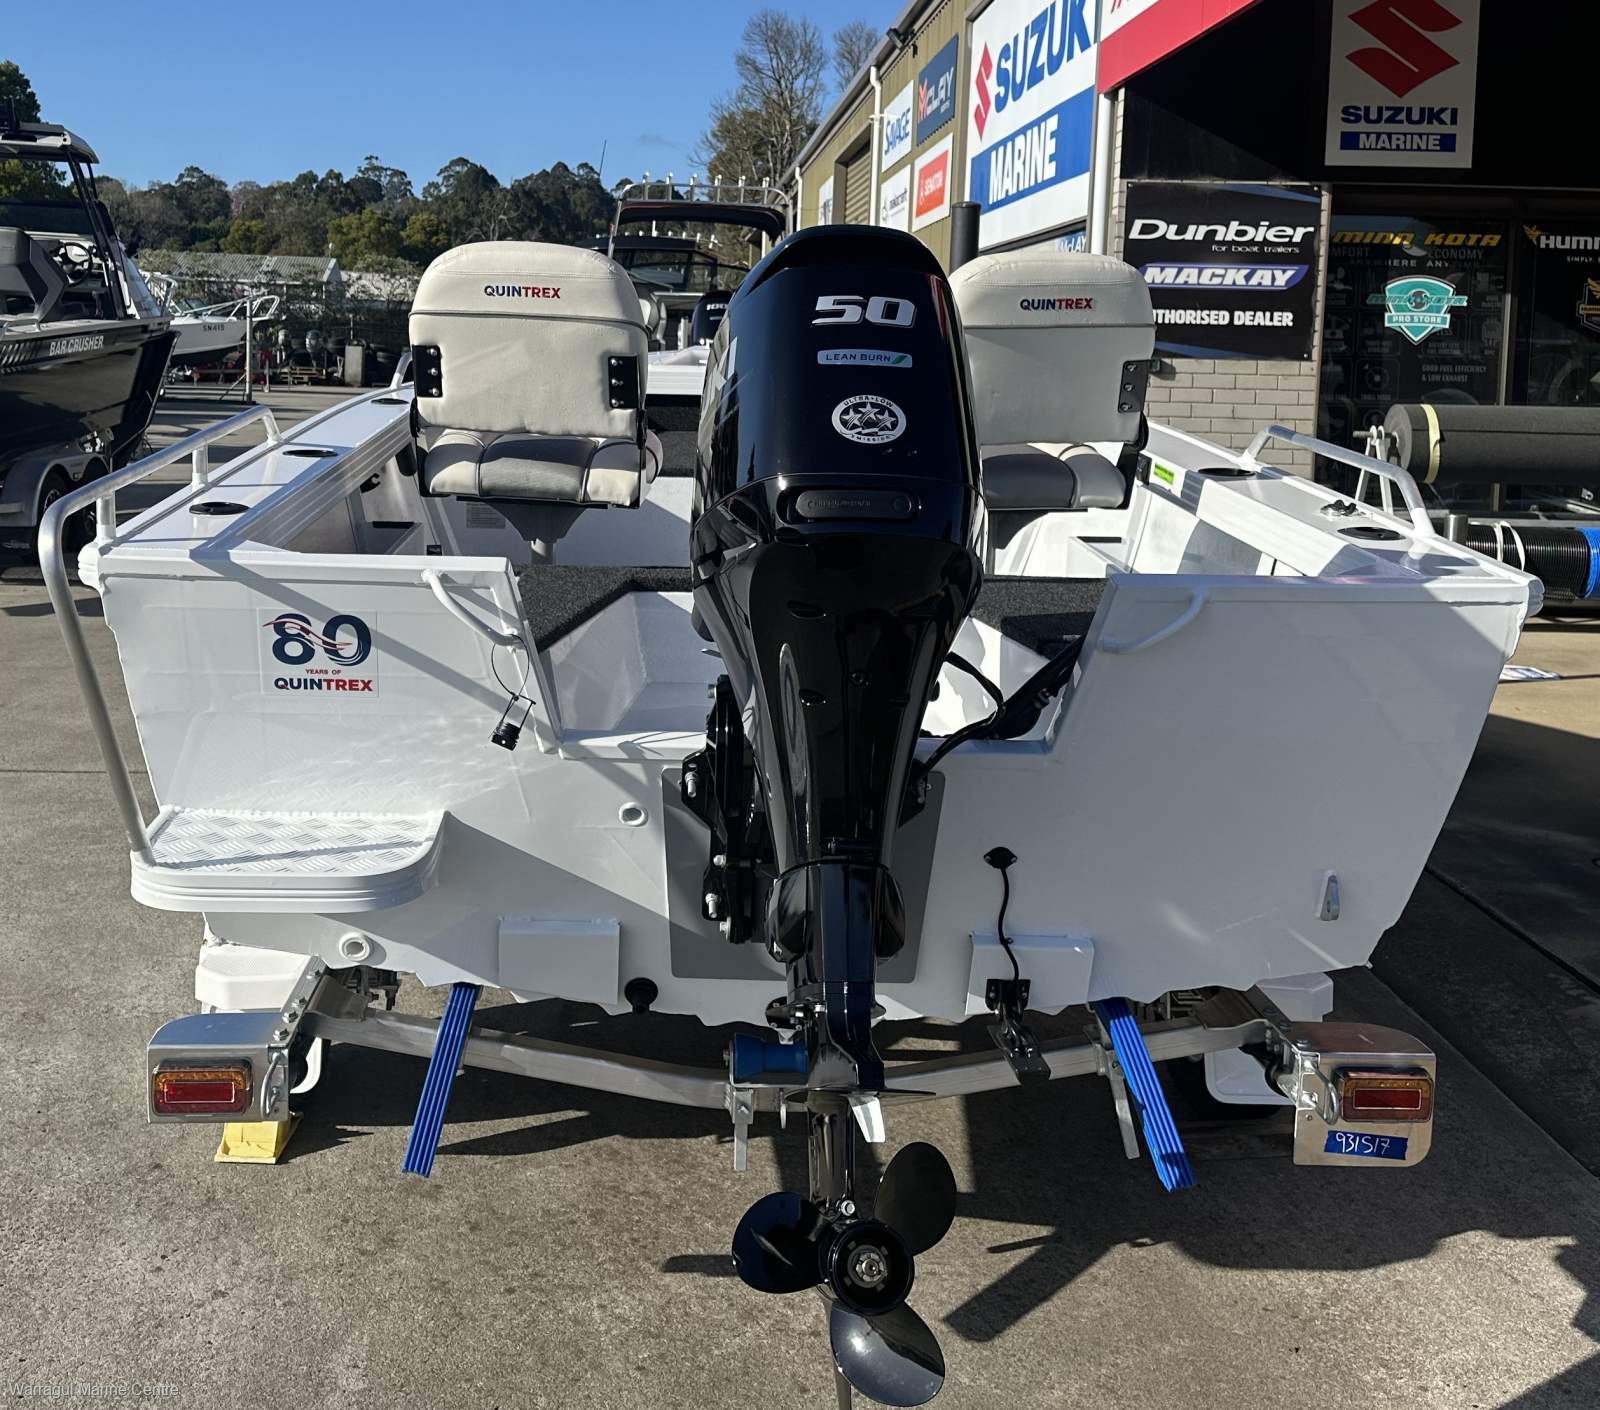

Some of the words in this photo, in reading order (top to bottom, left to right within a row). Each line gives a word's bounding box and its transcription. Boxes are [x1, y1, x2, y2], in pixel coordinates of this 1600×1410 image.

[995, 0, 1100, 113] SUZUK
[1341, 105, 1458, 125] SUZUKI
[1359, 133, 1441, 150] MARINE
[989, 113, 1059, 205] MARINE
[1128, 218, 1315, 243] Dunbier
[1211, 244, 1228, 252] for
[1231, 245, 1260, 253] boat
[1263, 245, 1301, 254] trailers
[1144, 267, 1297, 287] MACKAY
[484, 285, 561, 299] QUINTREX
[811, 295, 917, 328] 50
[1020, 298, 1093, 311] QUINTREX
[1234, 311, 1293, 327] DEALER
[1392, 315, 1411, 323] PRO
[1413, 315, 1442, 324] STORE
[49, 340, 67, 356] BAR
[68, 335, 104, 353] CRUSHER
[860, 354, 891, 362] BURN
[875, 396, 894, 408] LOW
[272, 613, 371, 666] 80
[274, 677, 373, 692] QUINTREX
